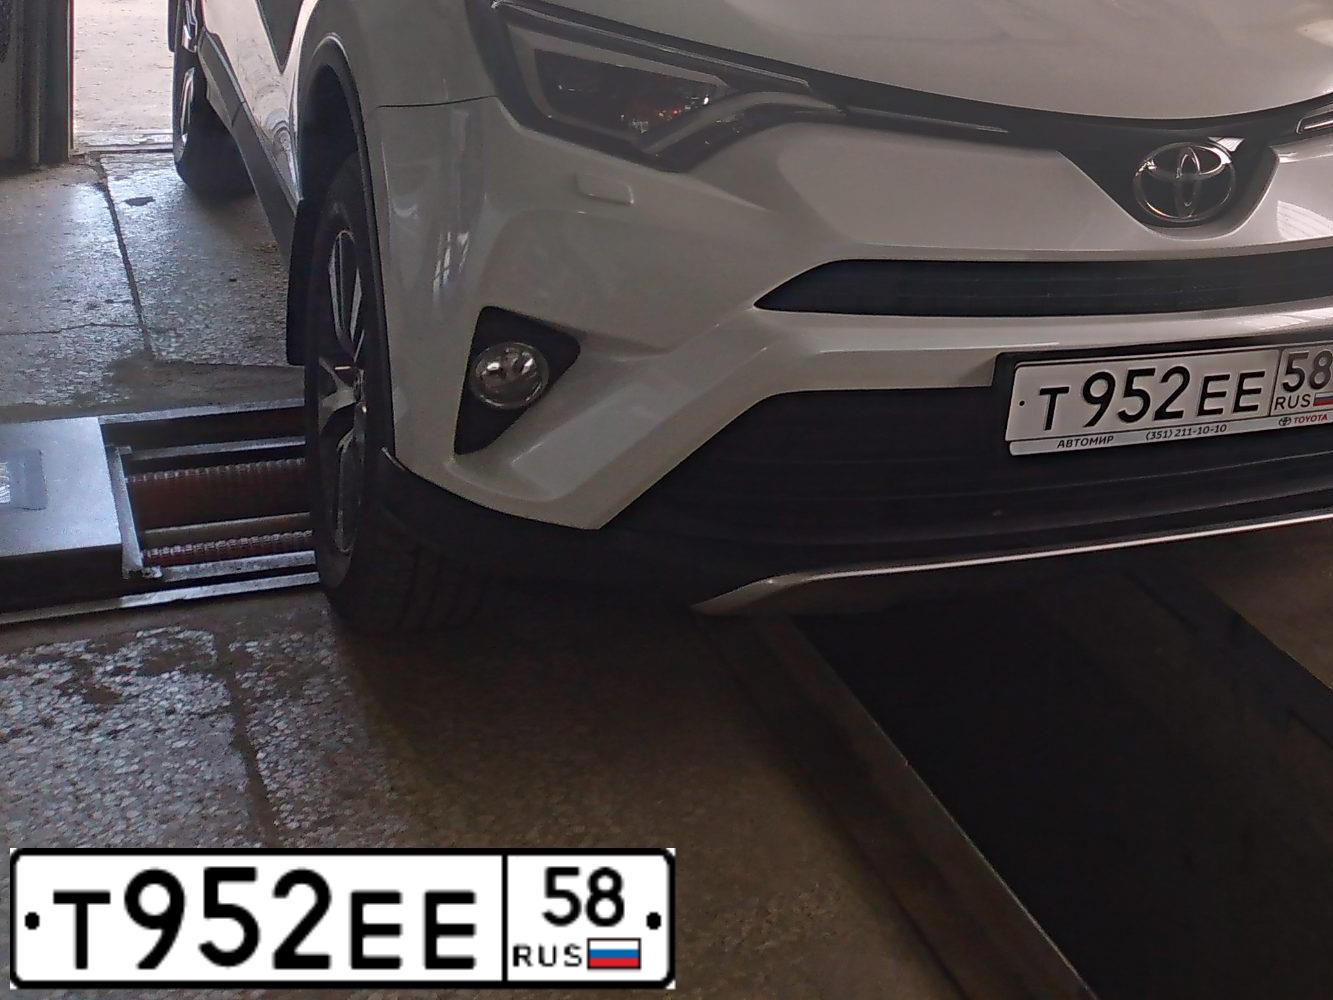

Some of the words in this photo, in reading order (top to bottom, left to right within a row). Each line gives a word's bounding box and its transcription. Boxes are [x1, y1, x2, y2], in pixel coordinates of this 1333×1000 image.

[1273, 392, 1312, 412] RUS
[1293, 413, 1329, 425] TOYOTA
[1056, 434, 1115, 450] АВТОМИР
[1145, 429, 1174, 442] (351)
[1173, 423, 1229, 439] 211-10-10
